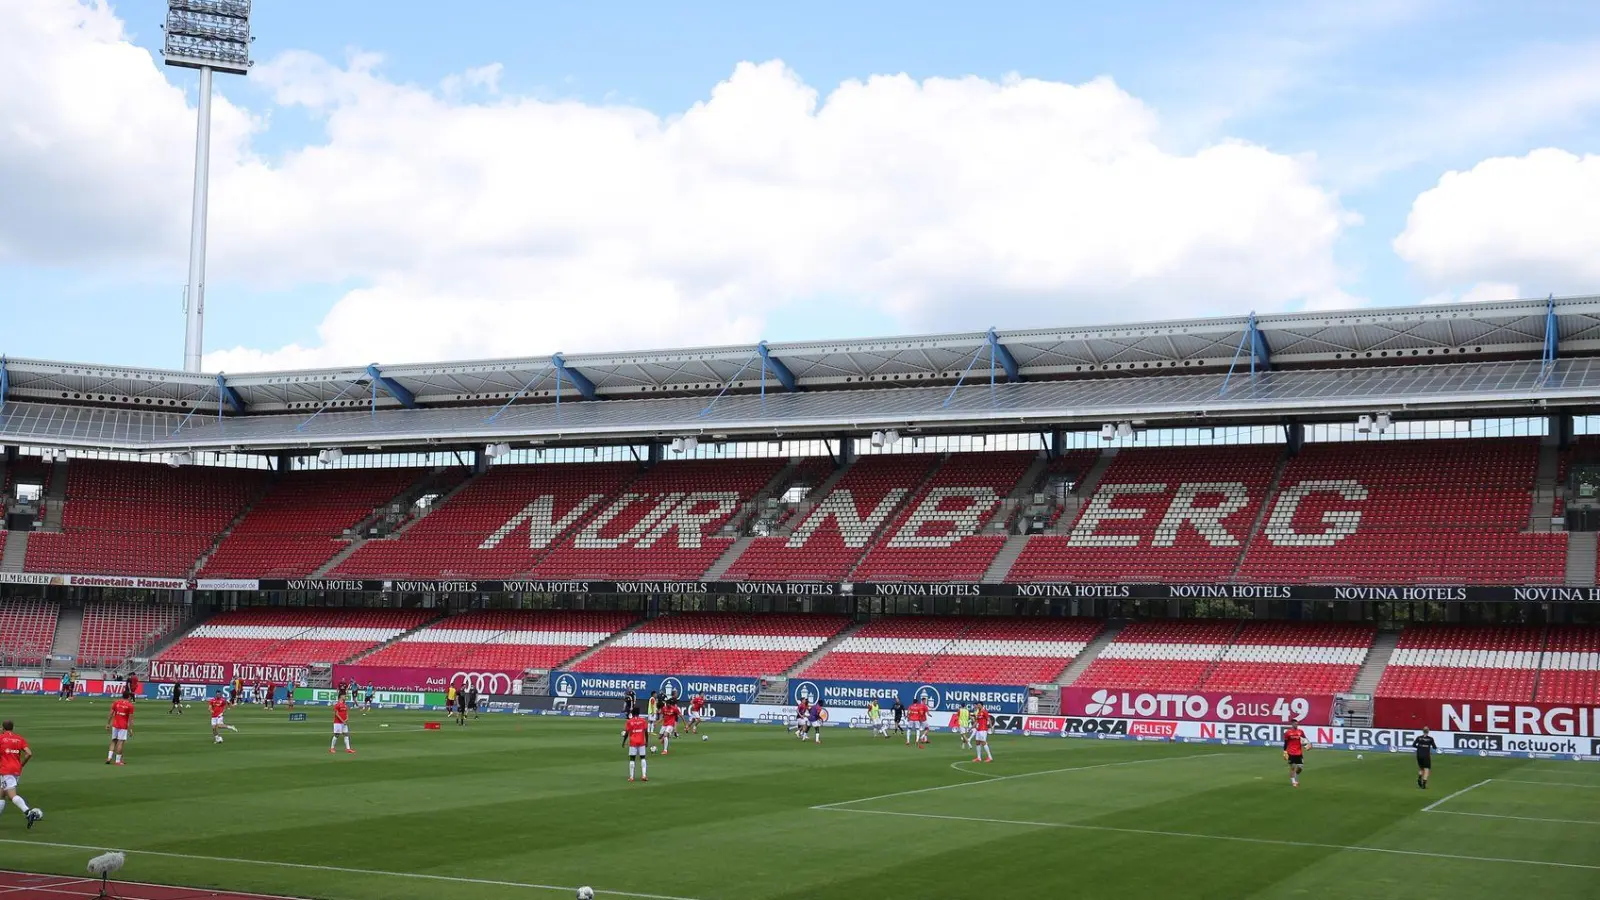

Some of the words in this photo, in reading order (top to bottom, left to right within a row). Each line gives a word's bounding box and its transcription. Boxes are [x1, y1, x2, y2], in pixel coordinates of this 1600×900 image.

[70, 576, 134, 587] Edelmetalle
[137, 579, 183, 588] Hanauer
[287, 580, 324, 590] NOVINA
[326, 580, 363, 590] HOTELS
[396, 581, 436, 592] NOVINA
[438, 582, 477, 592] HOTELS
[503, 582, 545, 592] NOVINA
[547, 582, 589, 592] HOTELS
[616, 583, 660, 592] NOVINA
[663, 583, 707, 593] HOTELS
[736, 583, 783, 594] NOVINA
[786, 583, 833, 595] HOTELS
[876, 584, 926, 595] NOVINA
[930, 585, 980, 595] HOTELS
[1017, 585, 1072, 596] NOVINA
[1075, 585, 1130, 597] HOTELS
[1170, 586, 1228, 597] NOVINA
[1232, 586, 1291, 598] HOTELS
[1335, 588, 1398, 599] NOVINA
[1403, 588, 1466, 600] HOTELS
[1514, 588, 1583, 600] NOVINA
[151, 661, 224, 679] KULMBACHER
[426, 677, 446, 685] Audi
[581, 678, 646, 690] NÜRNBERGER
[688, 682, 756, 693] NÜRNBERGER
[824, 686, 898, 699] NÜRNBERGER
[945, 690, 1024, 703] NÜRNBERGER
[1122, 693, 1208, 718] LOTTO
[1028, 718, 1059, 730] HEIZÖL
[1065, 718, 1128, 735] ROSA
[1133, 724, 1172, 735] PELLETS
[1458, 736, 1497, 749] noris
[1508, 739, 1576, 752] network
